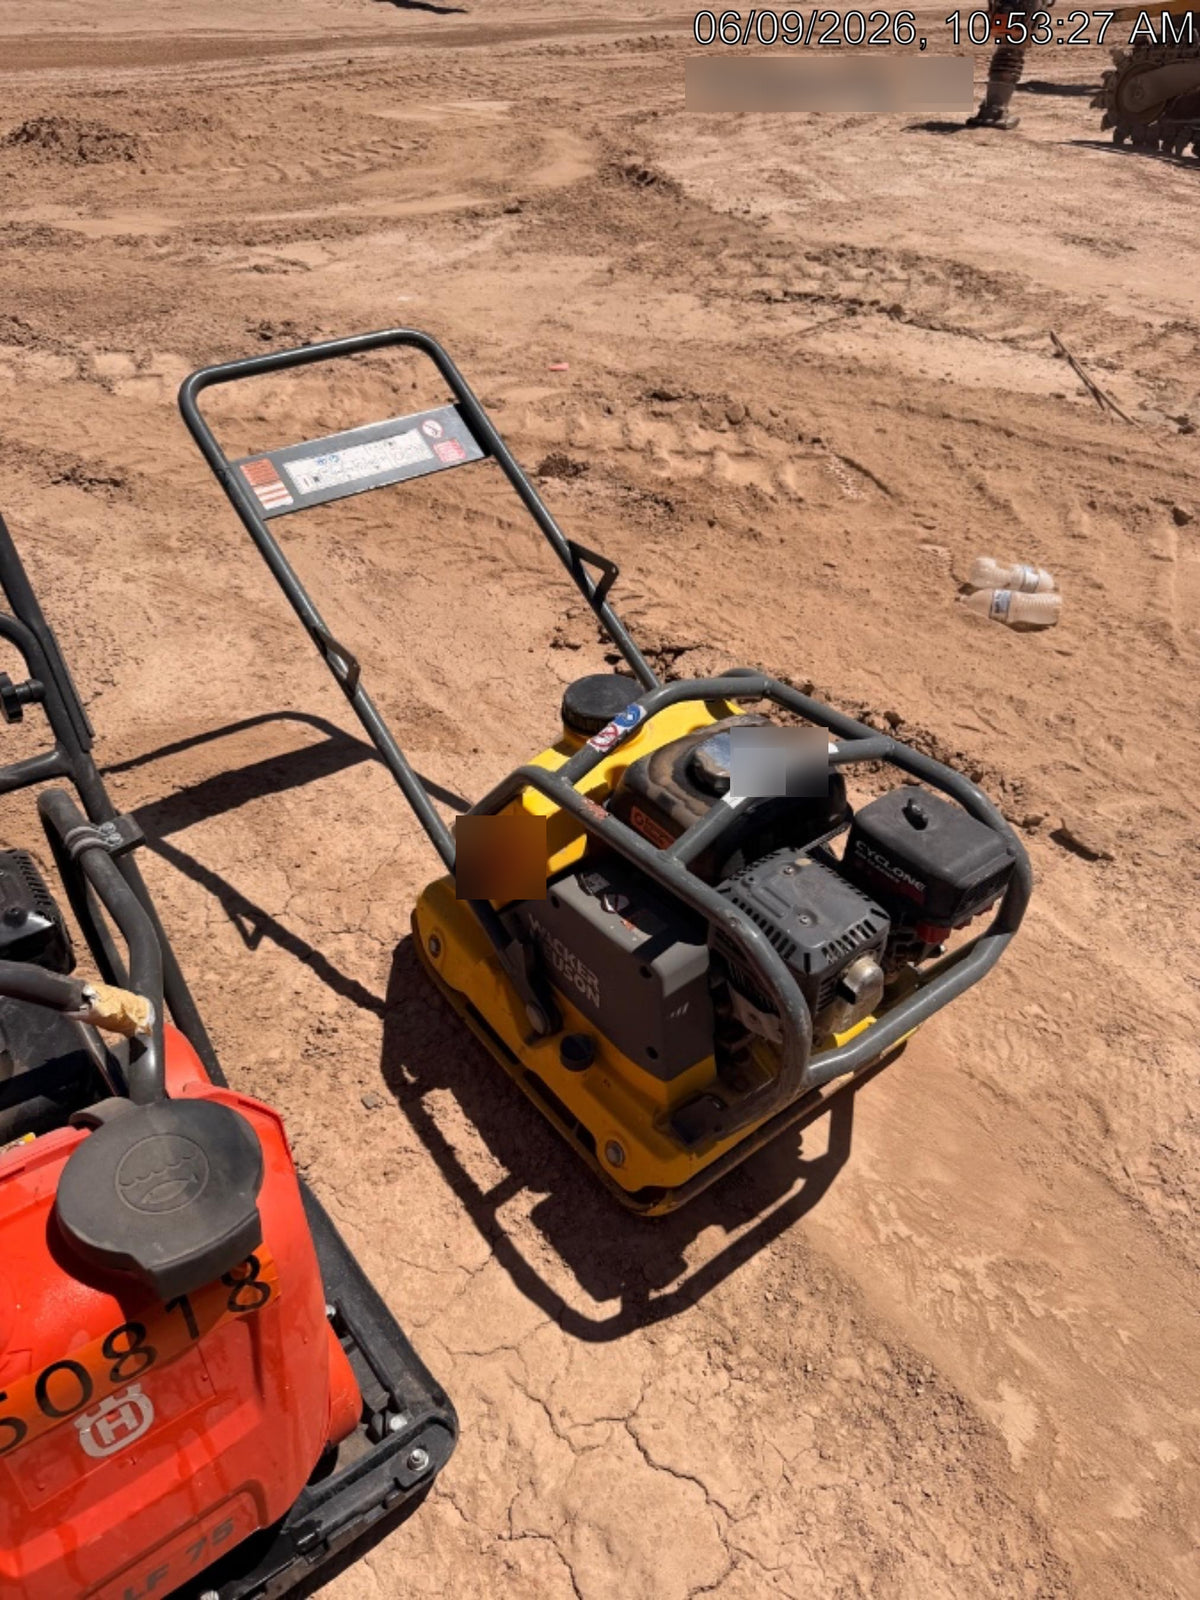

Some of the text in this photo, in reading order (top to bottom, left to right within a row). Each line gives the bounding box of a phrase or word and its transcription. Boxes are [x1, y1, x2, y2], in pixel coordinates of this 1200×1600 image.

[854, 839, 927, 892] CYCLONE
[528, 911, 600, 993] WACKER
[124, 1517, 235, 1600] LF 75
